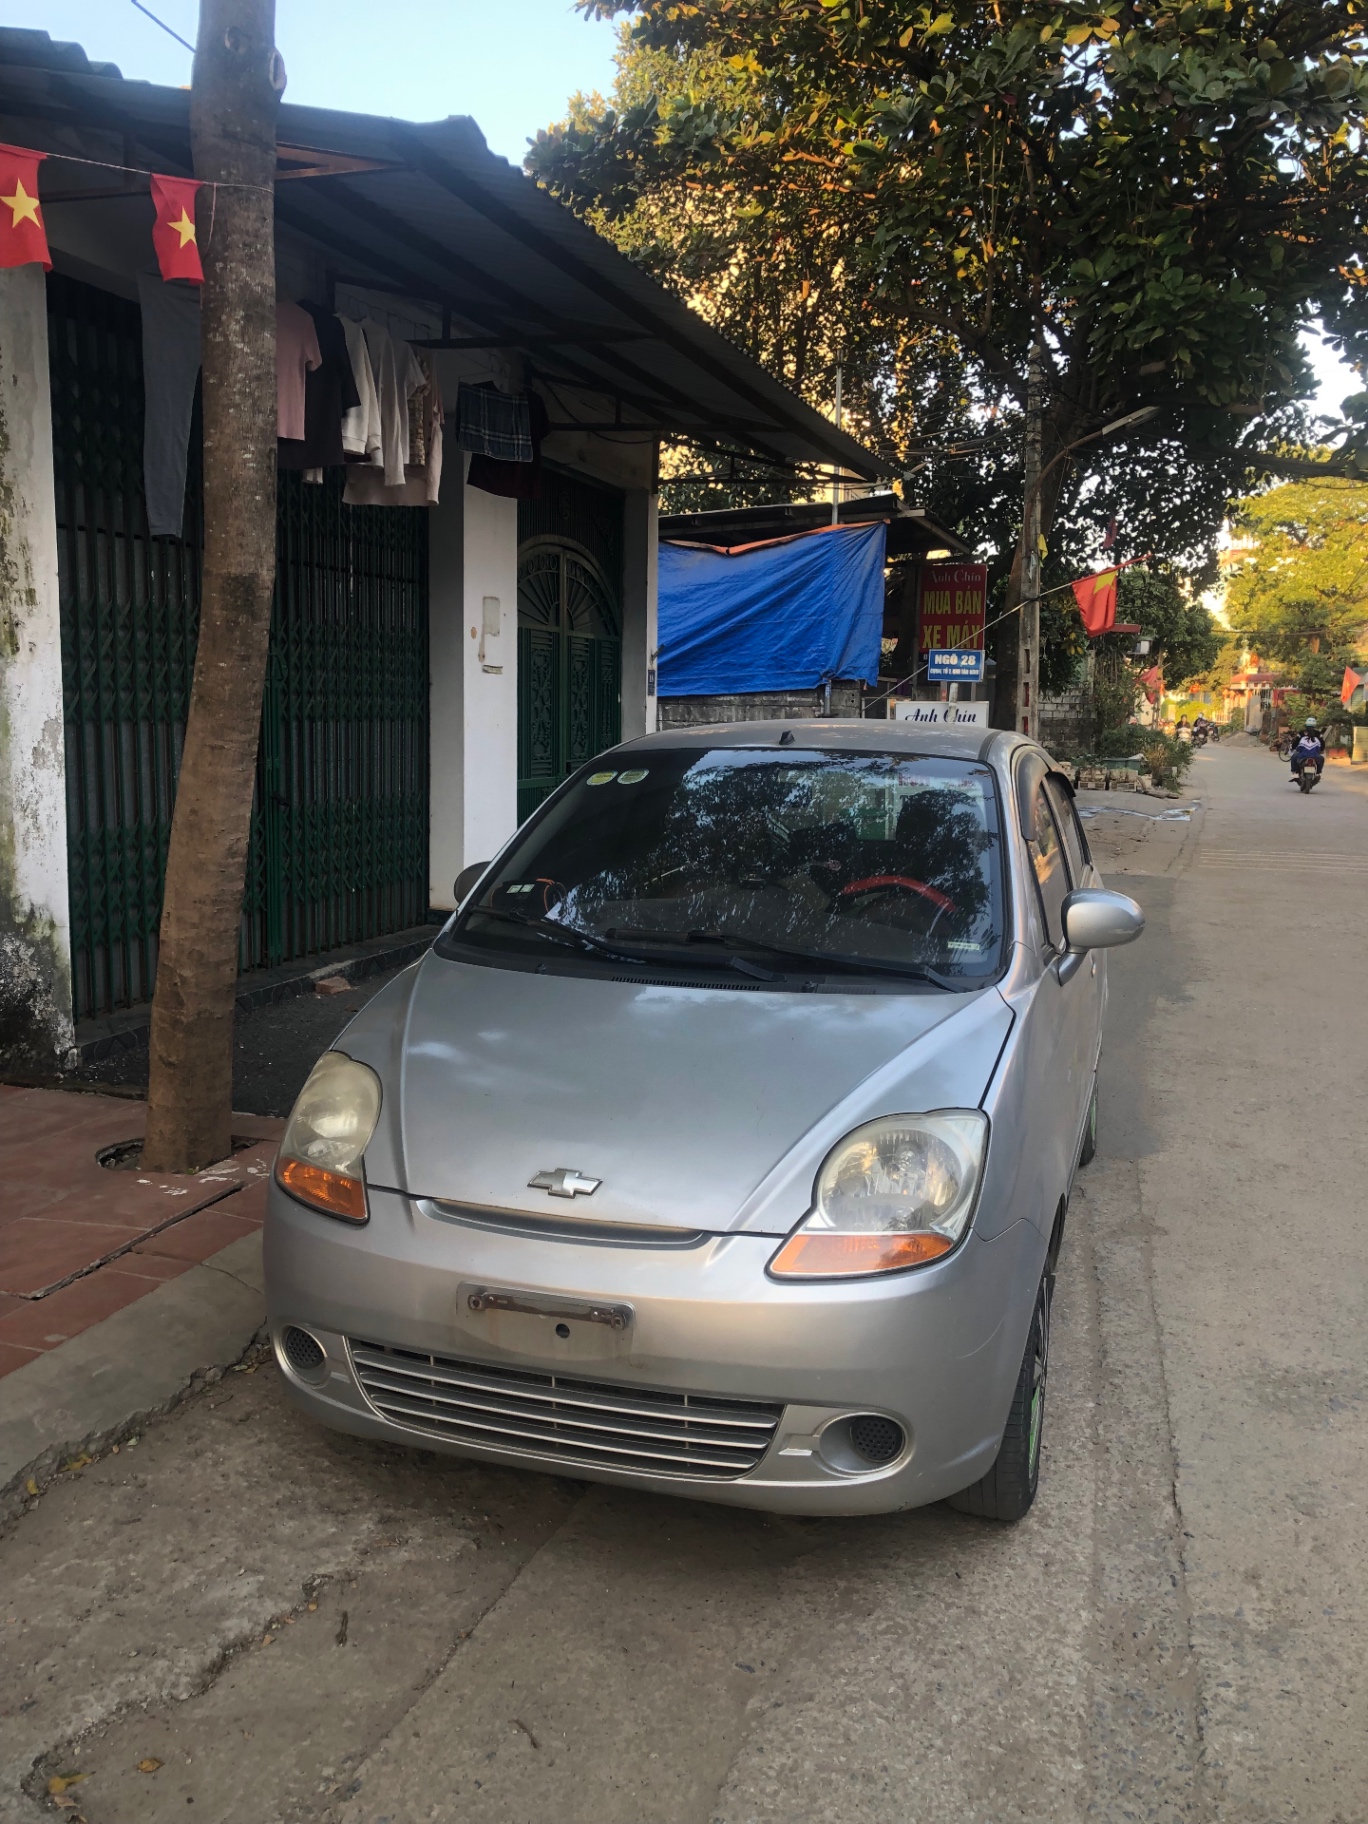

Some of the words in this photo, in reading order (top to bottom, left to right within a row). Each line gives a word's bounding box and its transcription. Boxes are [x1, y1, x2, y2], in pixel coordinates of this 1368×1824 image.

[923, 590, 951, 615] MUA
[955, 585, 982, 615] BÁN
[922, 625, 942, 649] XE
[946, 620, 981, 649] MÁY
[960, 655, 976, 665] 28
[905, 708, 938, 722] Anh
